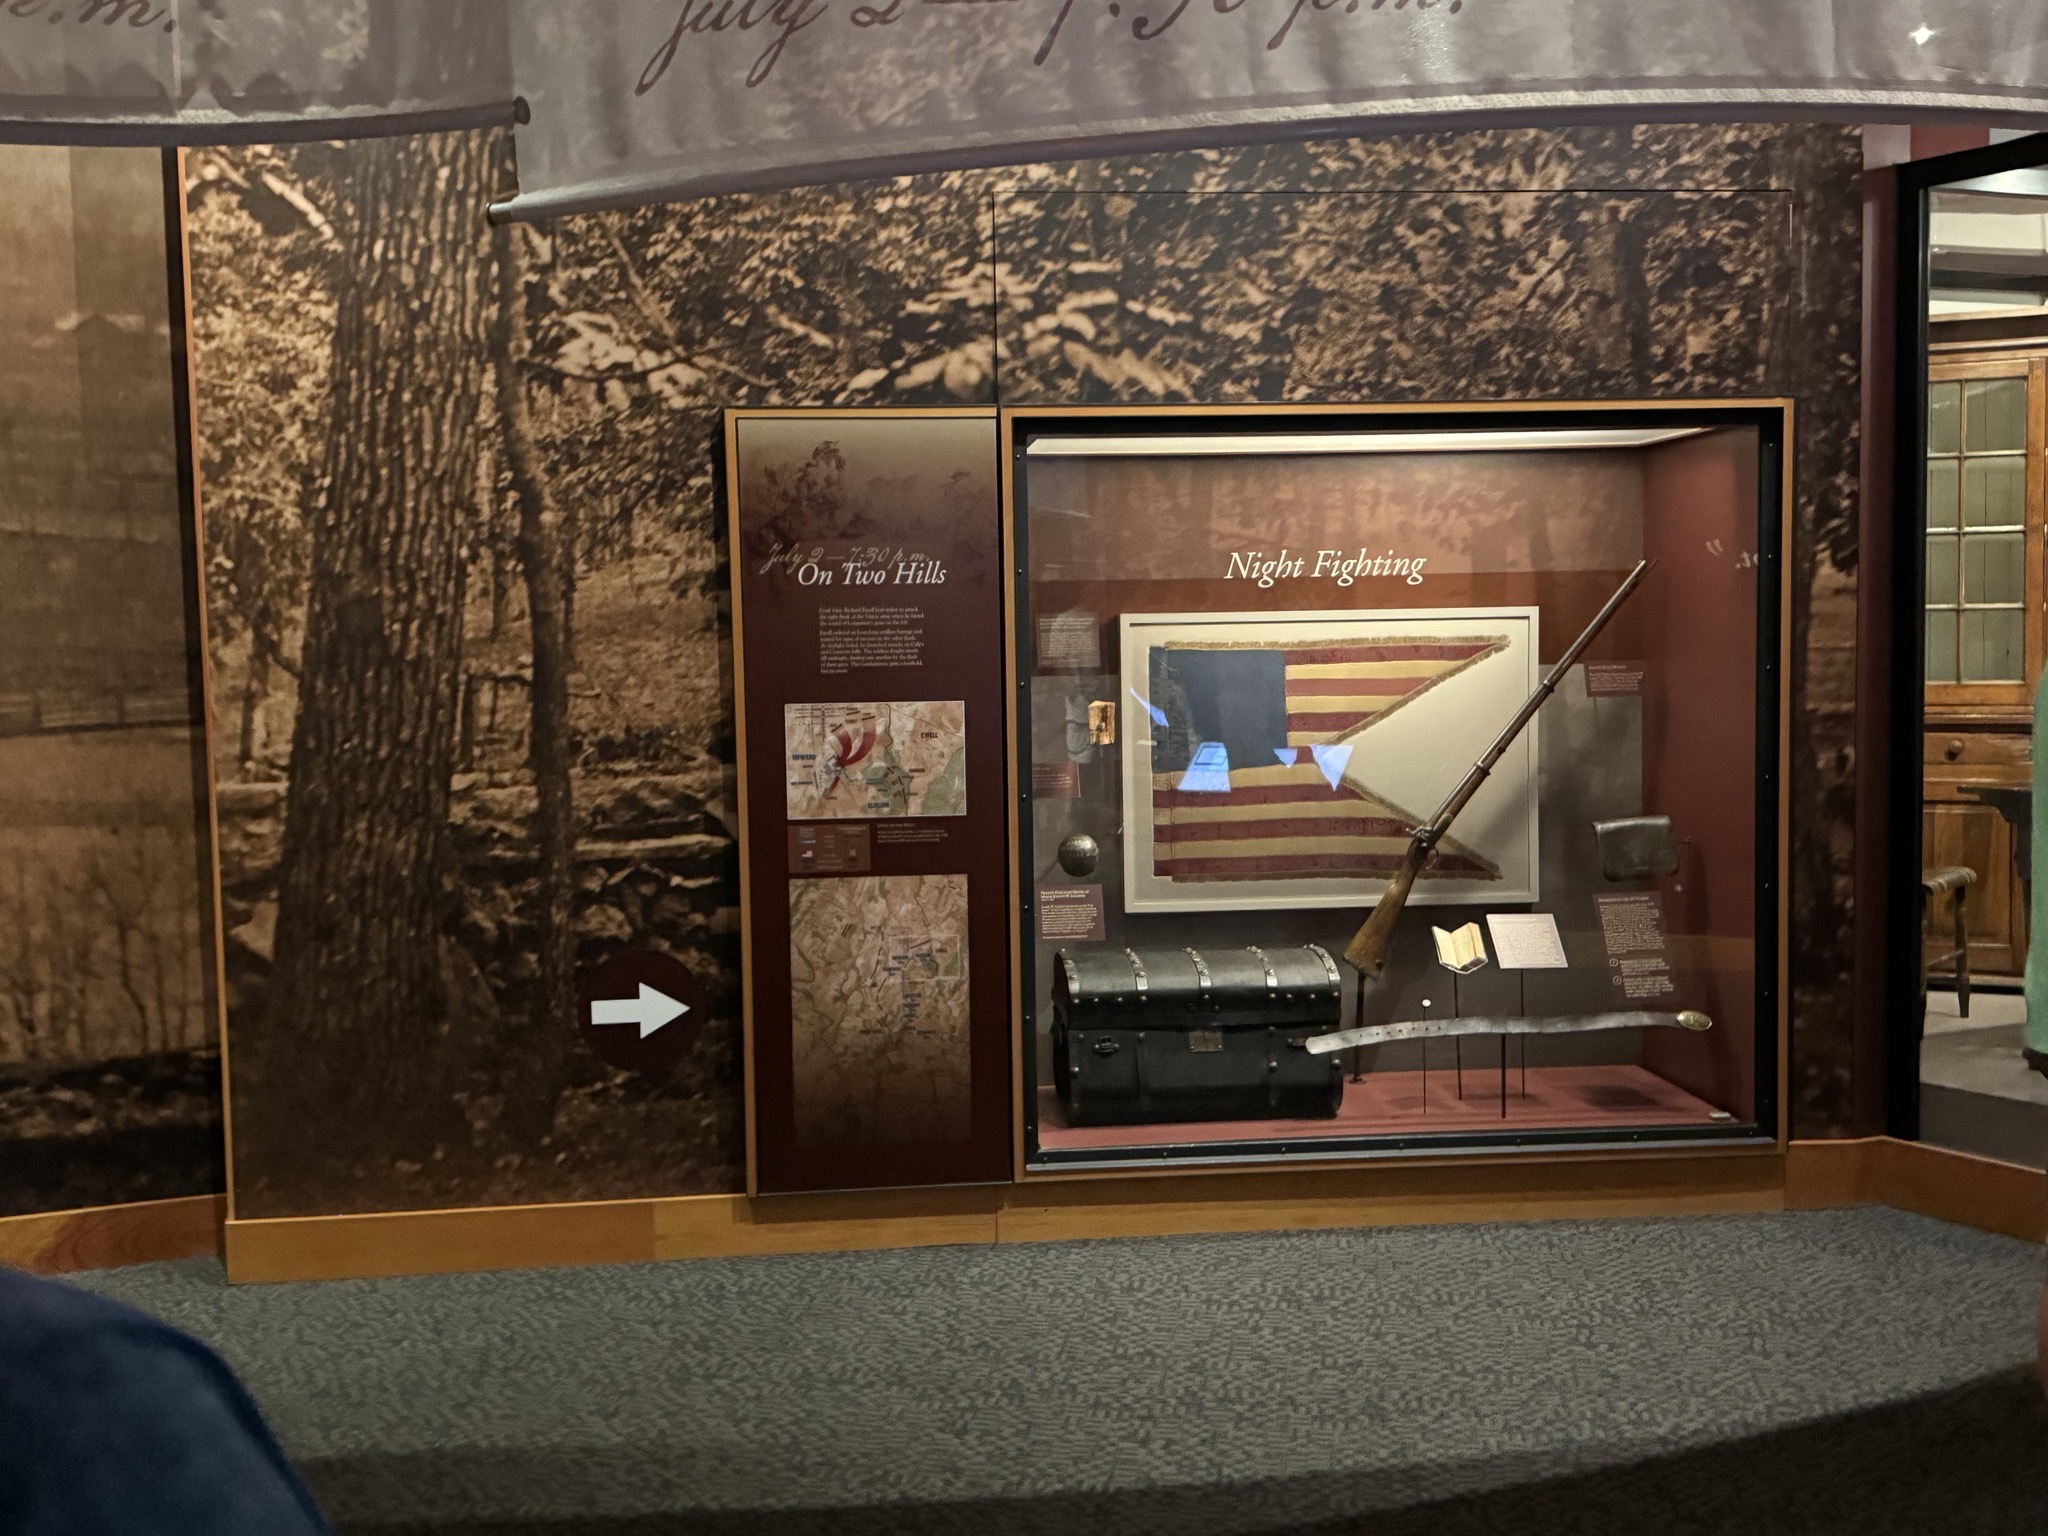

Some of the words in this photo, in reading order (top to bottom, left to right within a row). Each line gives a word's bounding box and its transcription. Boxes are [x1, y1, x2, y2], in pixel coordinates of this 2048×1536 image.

[759, 542, 803, 575] July
[798, 562, 832, 586] On
[842, 562, 887, 585] Two
[893, 560, 947, 585] Hills
[1224, 549, 1305, 588] Night
[1311, 548, 1427, 587] Fighting
